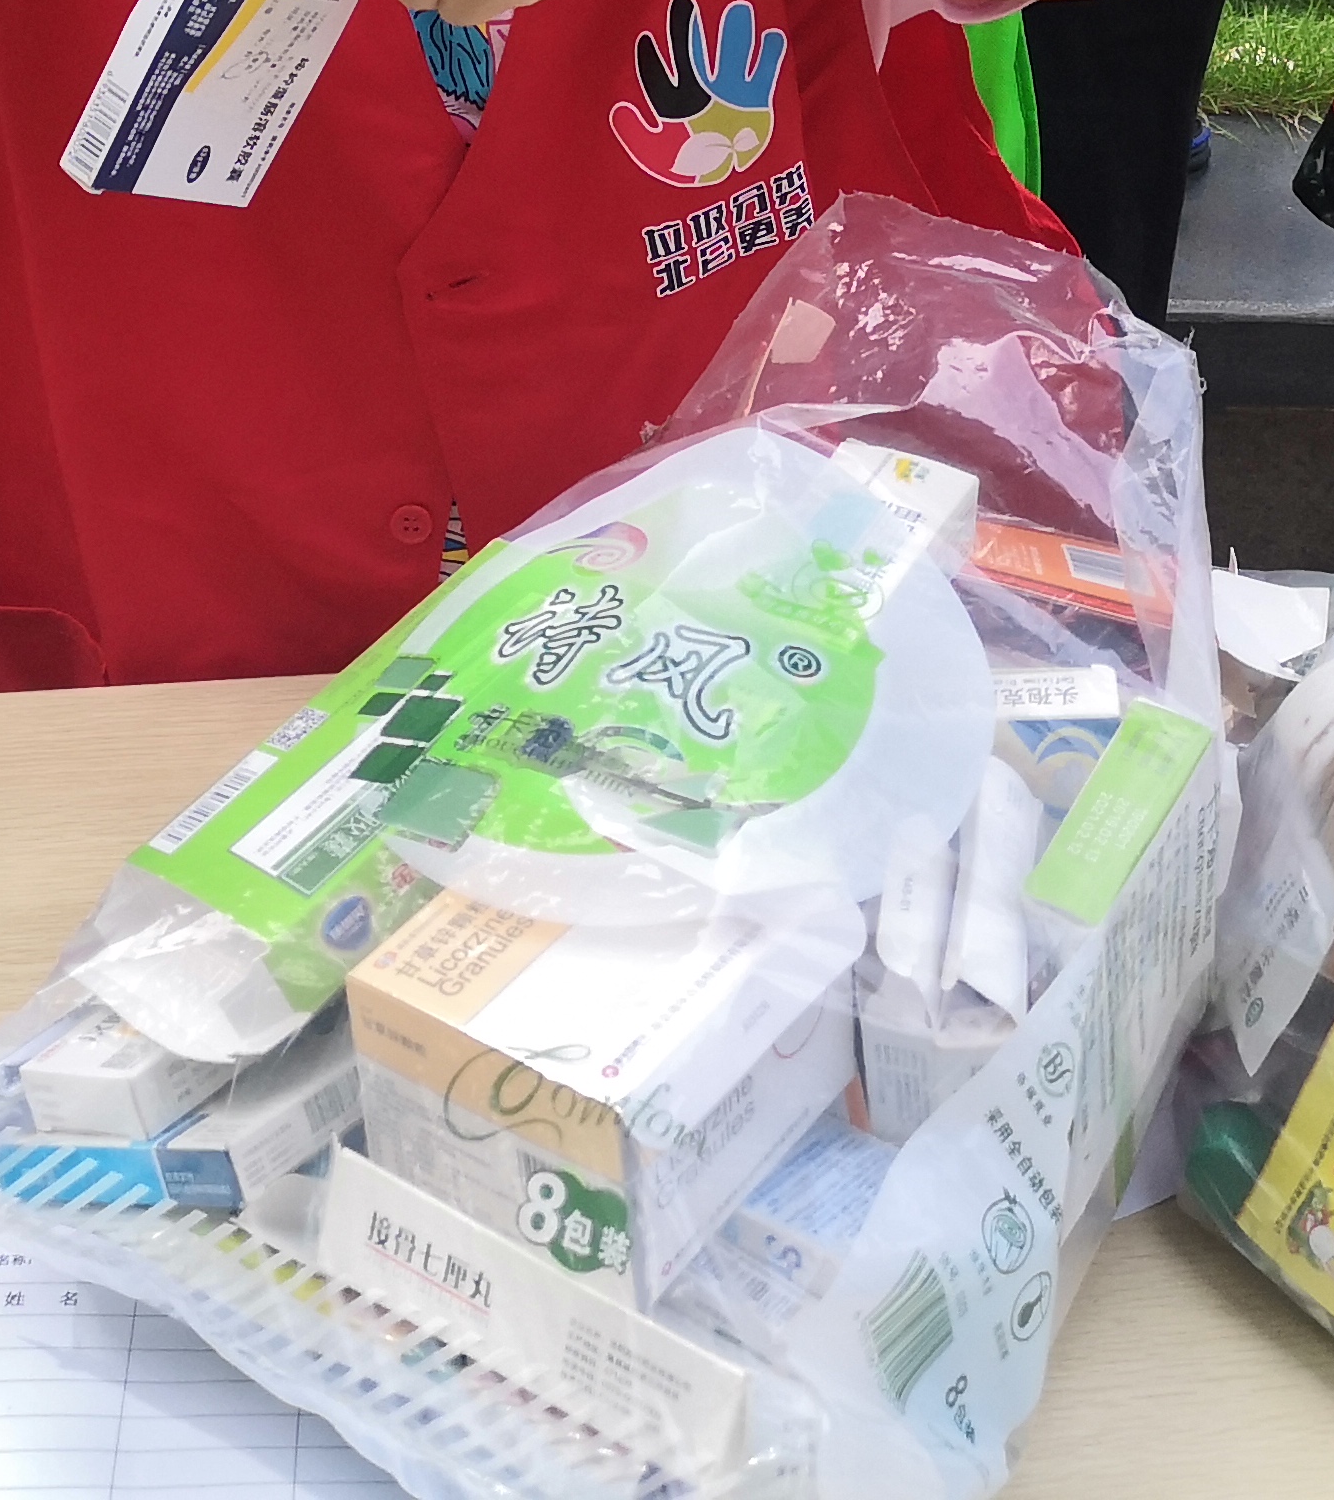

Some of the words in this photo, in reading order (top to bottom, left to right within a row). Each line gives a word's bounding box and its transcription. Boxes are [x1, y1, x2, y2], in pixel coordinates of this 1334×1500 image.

[497, 584, 750, 740] 清风
[416, 904, 514, 990] Licorzine
[436, 909, 534, 1000] Granules
